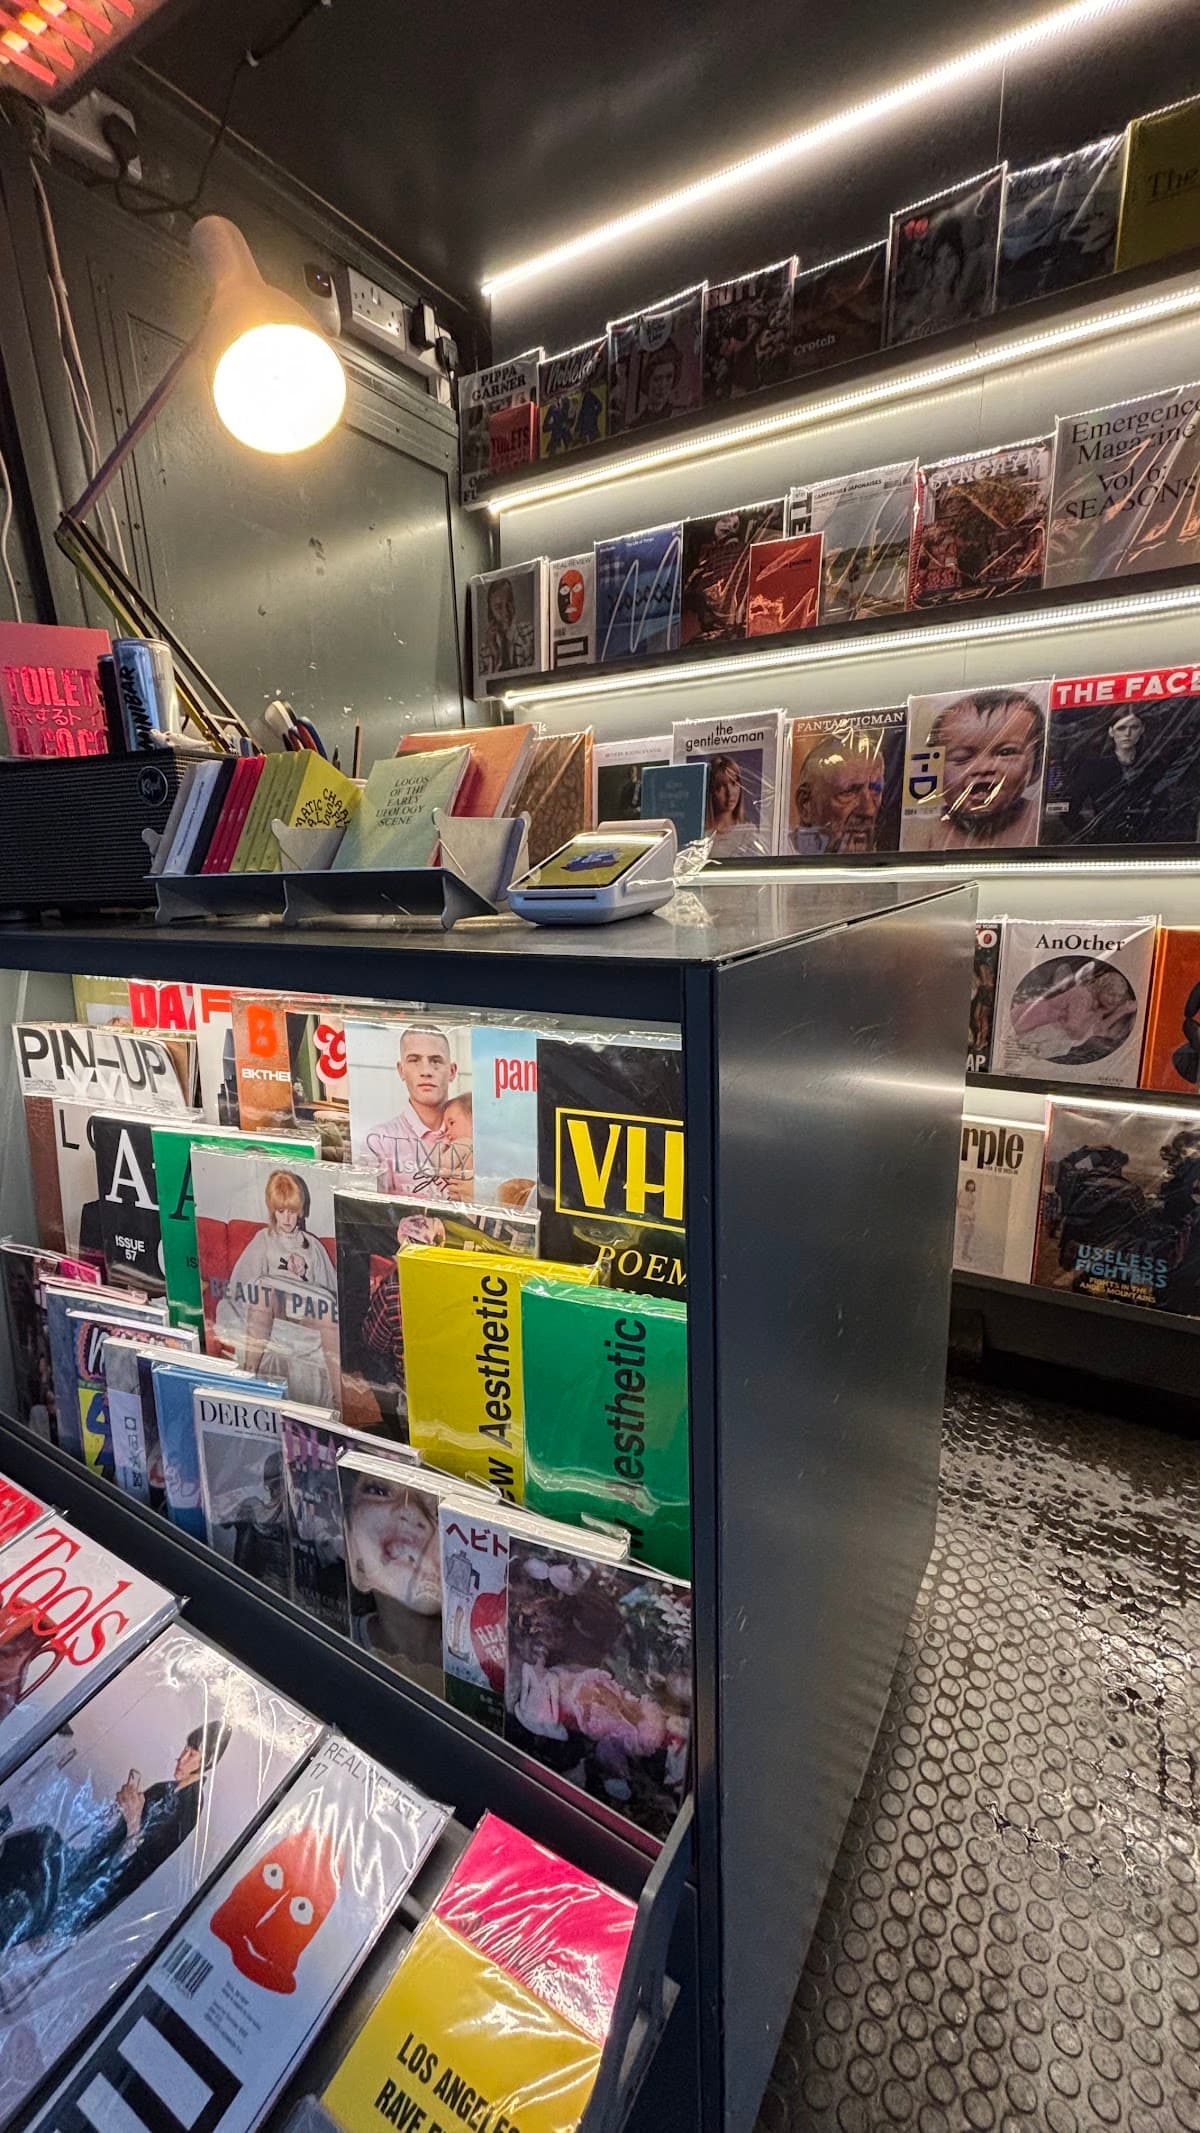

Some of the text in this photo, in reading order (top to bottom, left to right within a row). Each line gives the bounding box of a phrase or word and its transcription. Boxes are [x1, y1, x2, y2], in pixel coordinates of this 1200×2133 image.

[793, 334, 836, 357] Crotch
[472, 375, 526, 402] GARNER
[481, 365, 517, 387] PIPPA
[1078, 423, 1196, 466] Magazine
[1098, 467, 1135, 493] Vol
[1065, 476, 1200, 520] SEASONS
[2, 665, 102, 708] TOILET
[1057, 670, 1200, 705] THE FACE
[685, 730, 764, 752] gentlewoman
[716, 723, 733, 736] the
[395, 775, 430, 788] LOGOS
[377, 815, 413, 827] SCENE
[1035, 933, 1125, 951] AnOther
[17, 1027, 167, 1094] PIN-UP
[115, 1234, 145, 1253] ISSUE
[125, 1249, 137, 1262] 57
[1077, 1243, 1168, 1274] USELESS
[1075, 1258, 1168, 1290] FIGHTERS
[472, 1275, 512, 1449] Aesthetic
[199, 1400, 251, 1429] DER
[0, 1527, 133, 1667] Tools
[309, 1761, 329, 1781] 17
[323, 1742, 364, 1780] REAL
[396, 2032, 439, 2084] LOS
[374, 2077, 427, 2133] RAVE
